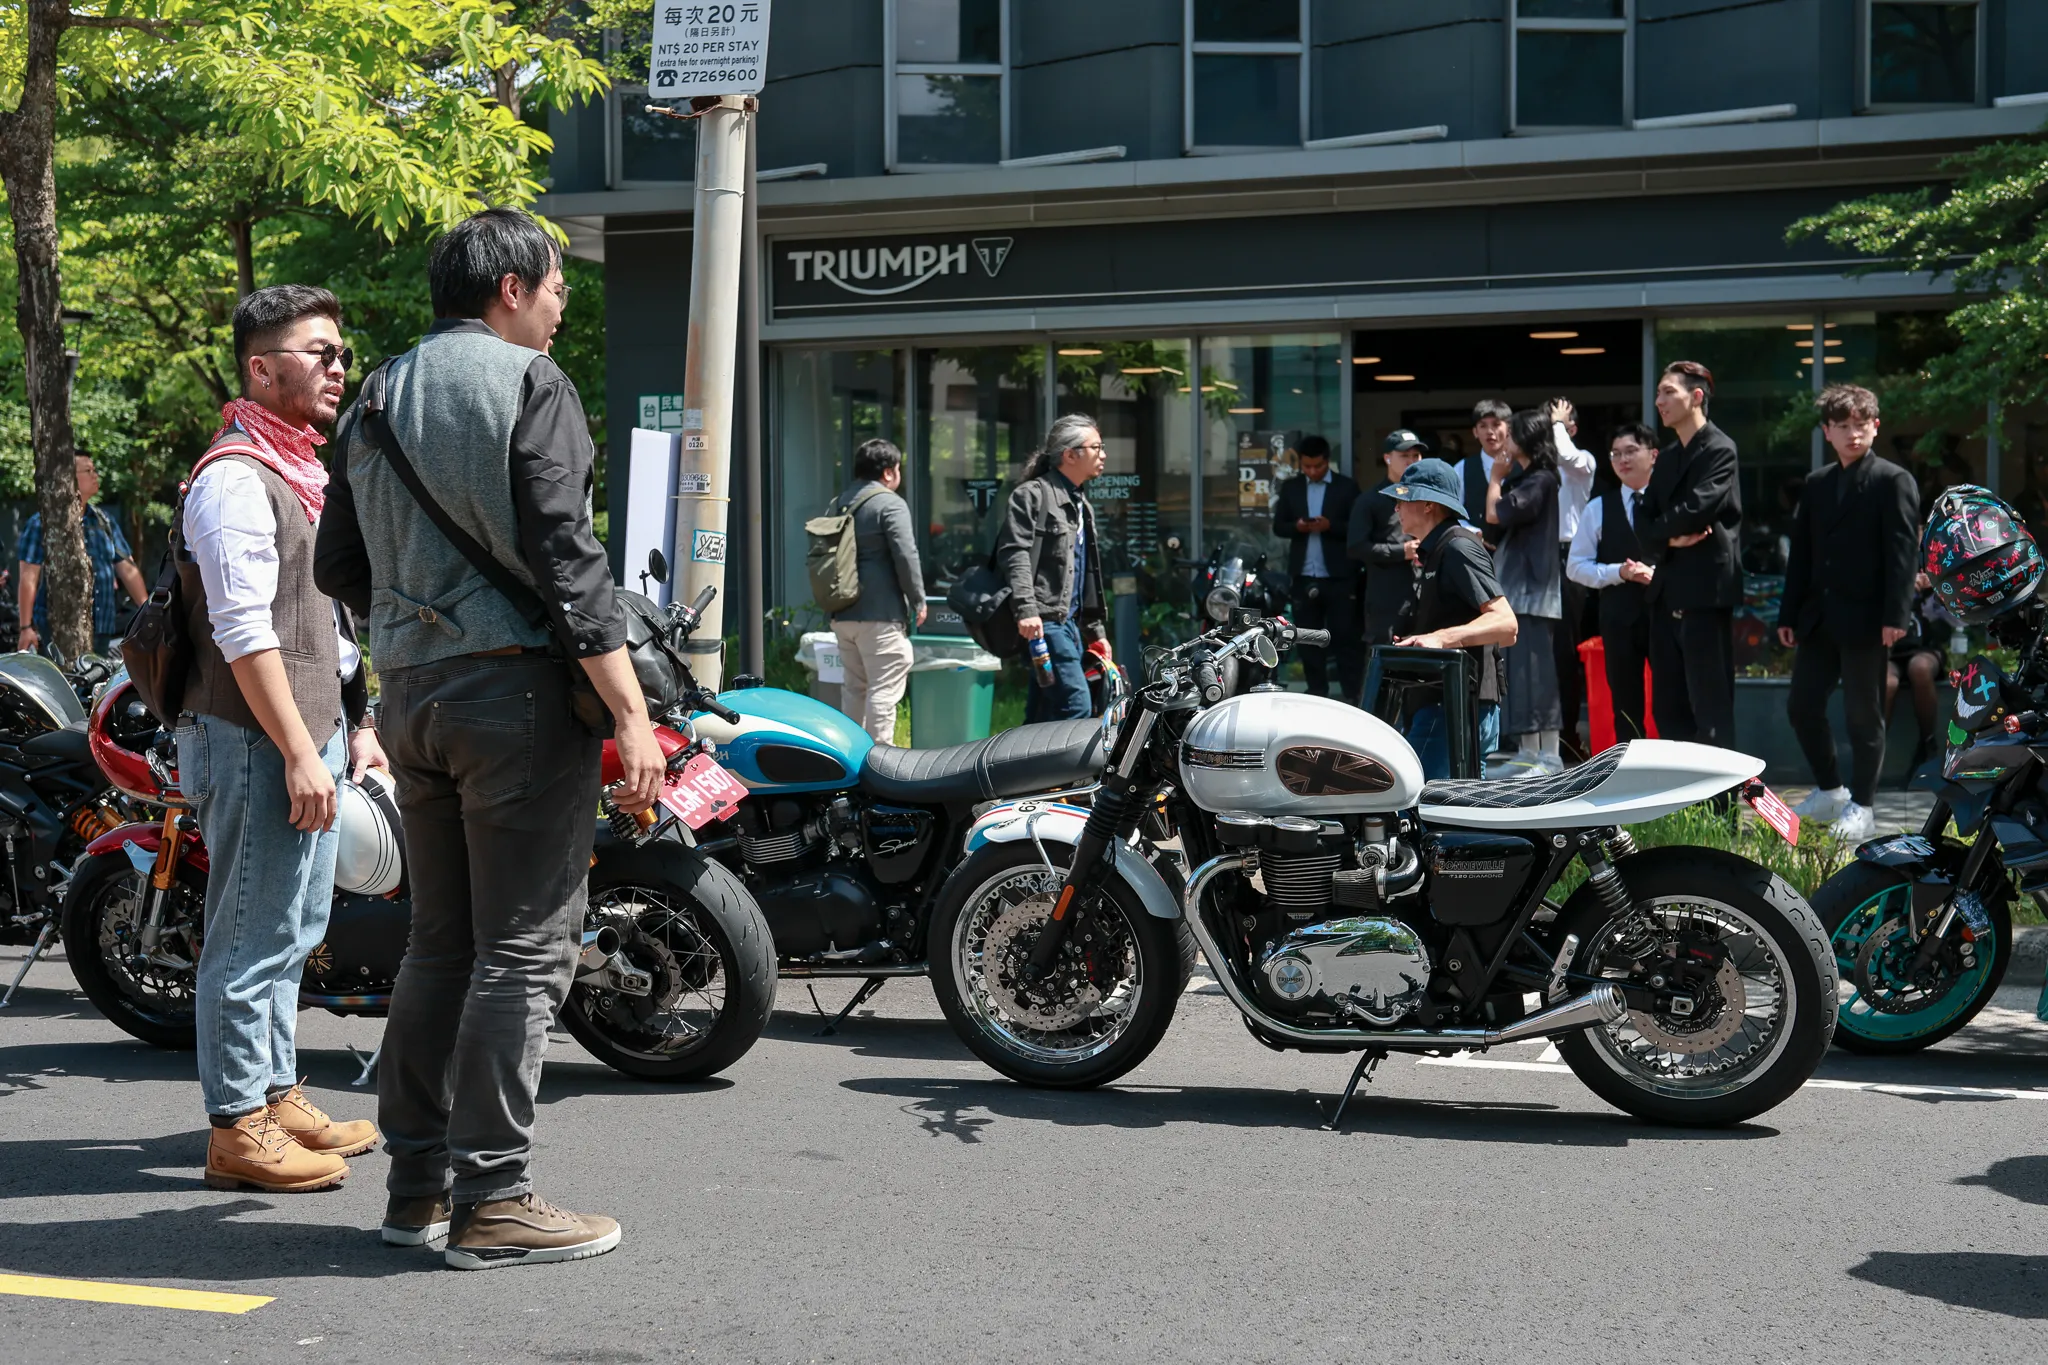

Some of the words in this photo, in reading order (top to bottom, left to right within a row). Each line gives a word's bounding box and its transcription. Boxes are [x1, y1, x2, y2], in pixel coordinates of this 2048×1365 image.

[664, 3, 758, 26] 每次20元
[658, 42, 680, 54] NT$
[683, 43, 698, 54] 20
[702, 42, 724, 53] PER
[728, 40, 759, 52] STAY
[657, 58, 676, 68] (extra
[678, 58, 688, 67] fee
[689, 57, 698, 66] for
[700, 56, 730, 67] overnight
[731, 55, 759, 66] parking)
[681, 69, 757, 83] 27269600
[788, 244, 967, 295] TRIUMPH
[1089, 475, 1140, 487] OPENING
[1089, 487, 1130, 499] HOURS
[936, 612, 963, 623] PUSH
[873, 838, 918, 855] Spirit
[1439, 860, 1506, 870] BONNEVILLE
